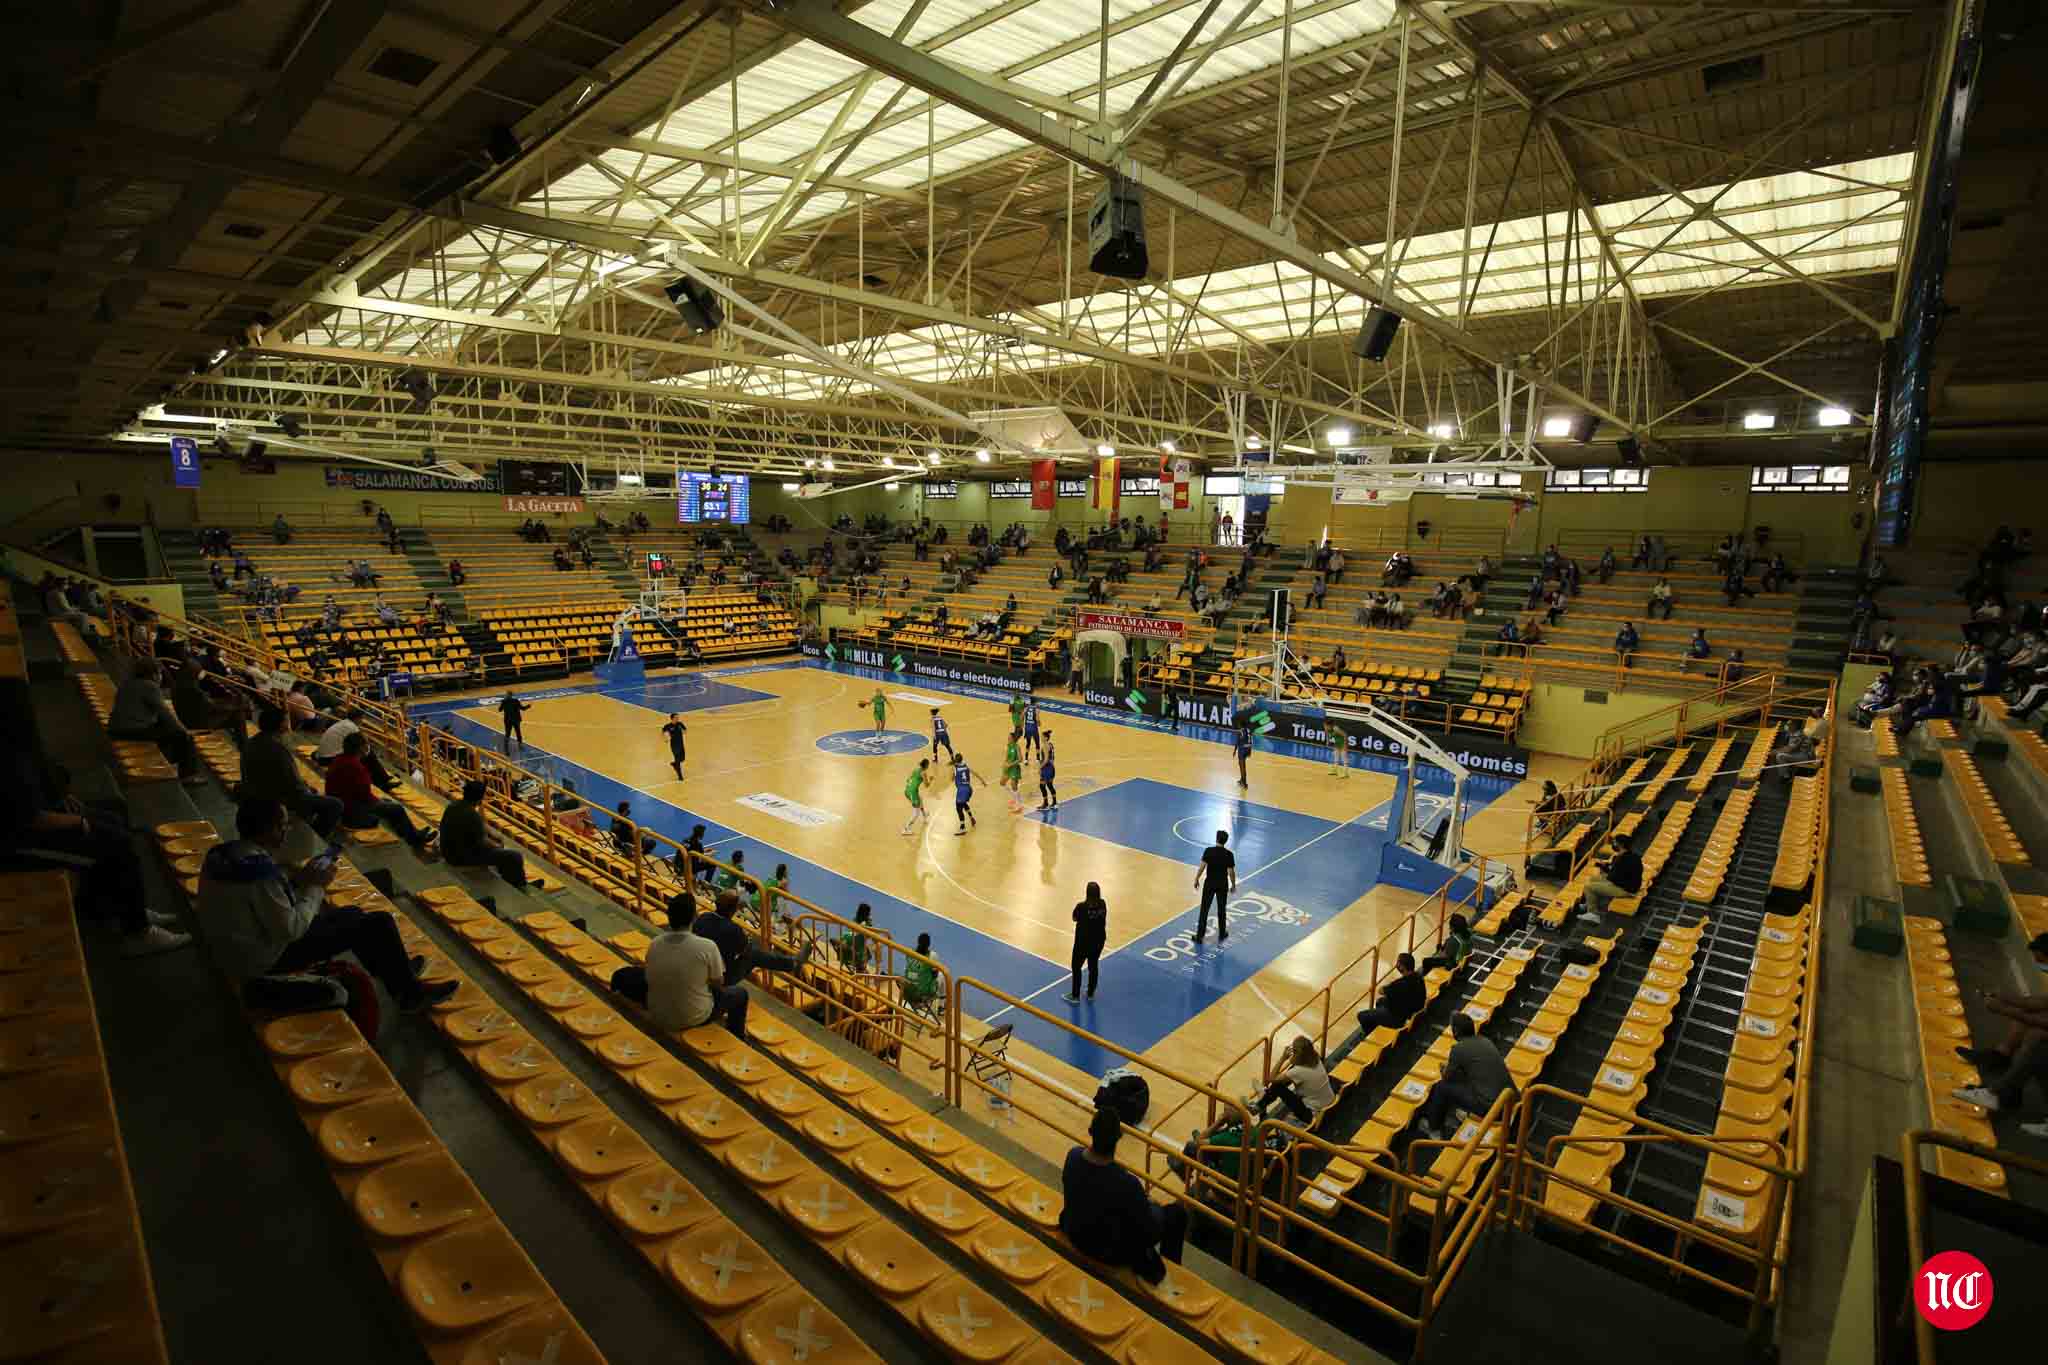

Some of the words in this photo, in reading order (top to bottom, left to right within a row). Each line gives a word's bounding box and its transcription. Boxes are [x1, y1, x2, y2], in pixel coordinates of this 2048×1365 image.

[182, 449, 191, 466] 8
[355, 474, 435, 489] SALAMANCA
[1098, 616, 1169, 630] SALAMANCA
[853, 650, 884, 667] MILAR
[913, 662, 948, 679] Tiendas
[949, 668, 961, 680] de
[963, 671, 1032, 692] electrodomés
[1086, 690, 1115, 705] ticos
[1178, 701, 1233, 726] MILAR
[1292, 722, 1357, 747] Tiens
[1361, 735, 1384, 751] de
